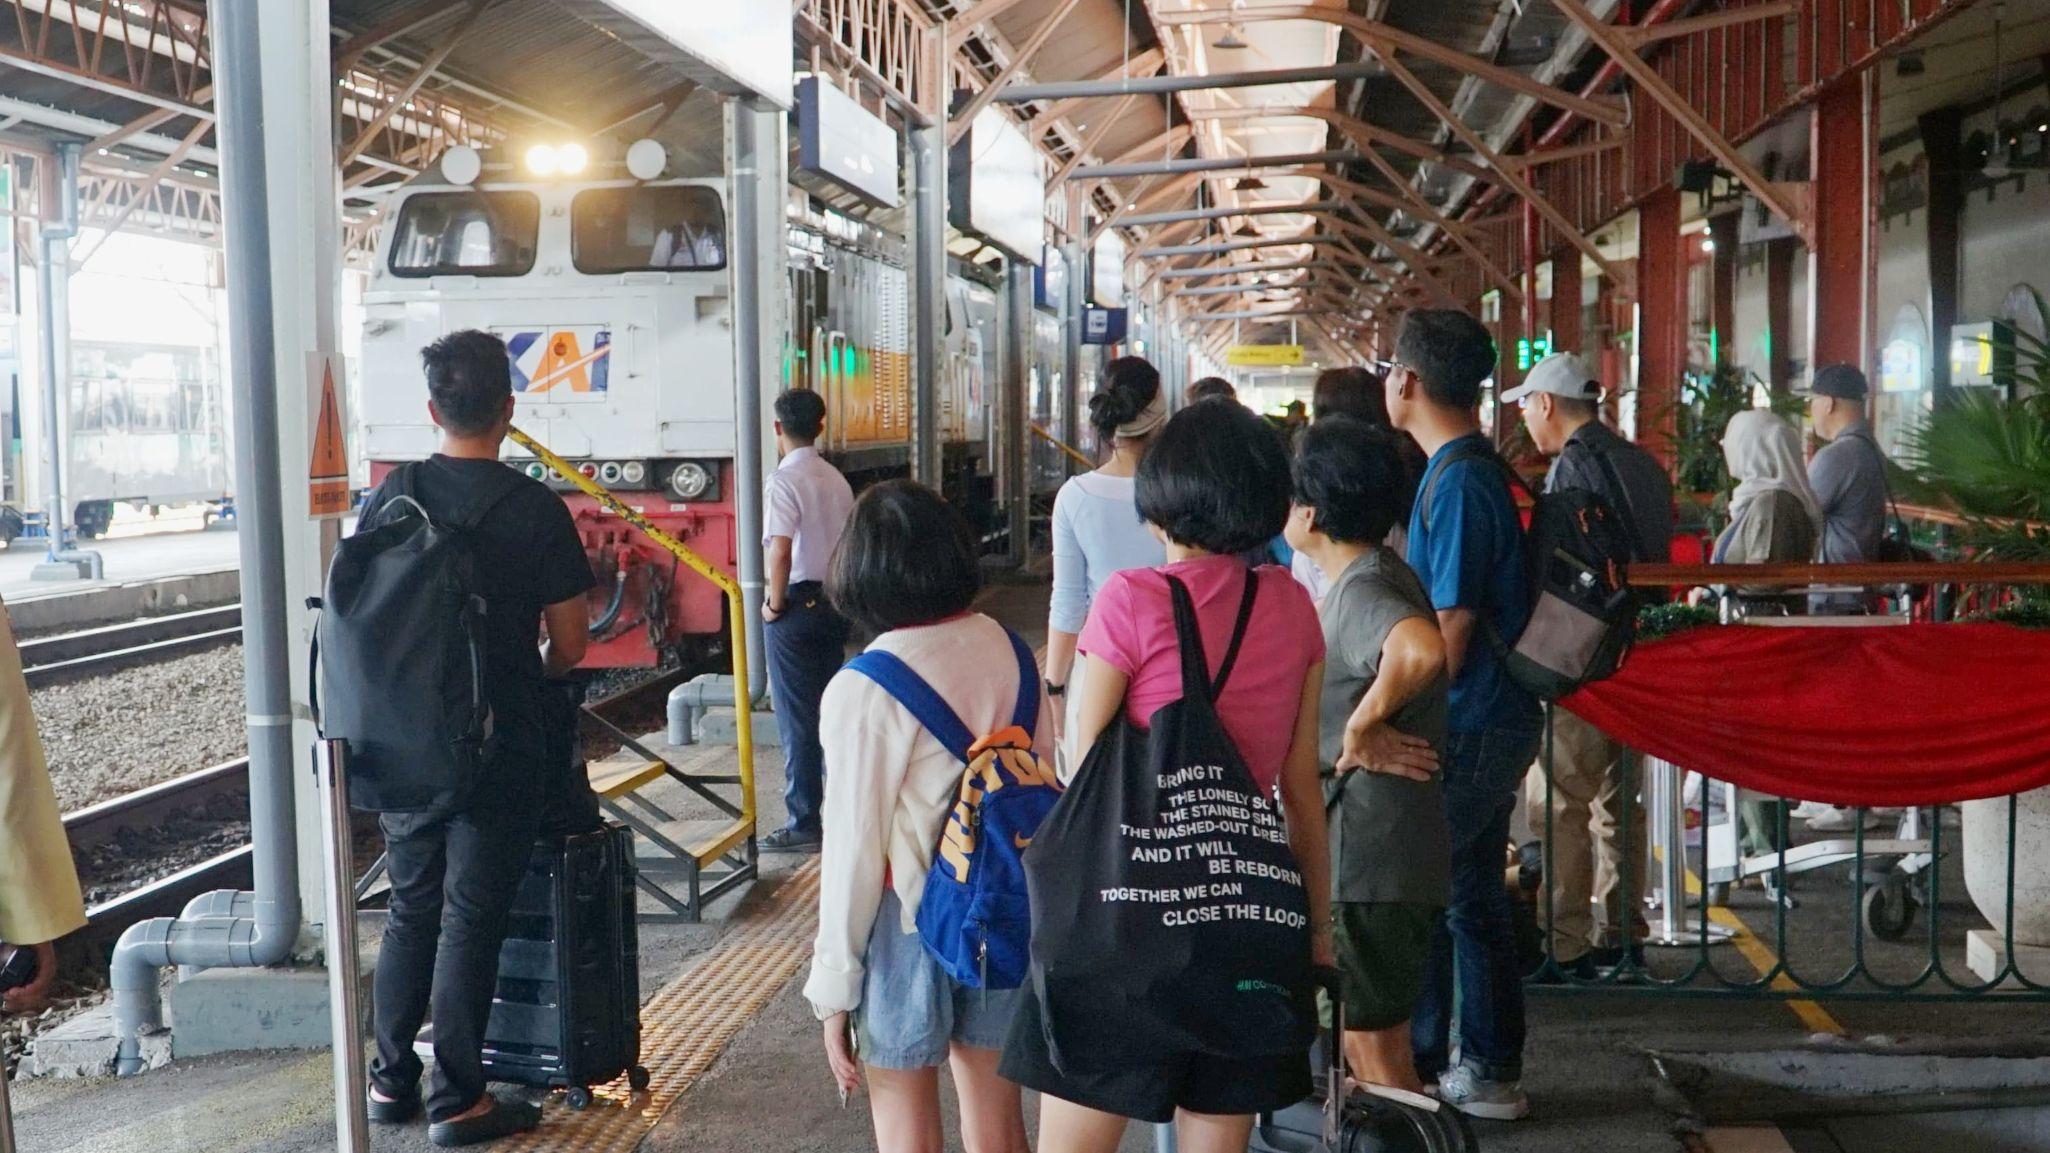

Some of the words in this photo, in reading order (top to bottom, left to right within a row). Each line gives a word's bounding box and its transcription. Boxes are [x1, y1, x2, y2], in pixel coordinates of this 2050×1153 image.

[507, 331, 611, 392] KAI
[1157, 765, 1205, 789] BRING
[1208, 765, 1224, 781] IT
[1168, 789, 1197, 808] THE
[1198, 788, 1250, 806] LONELY
[1160, 808, 1189, 824] THE
[1191, 804, 1251, 820] STAINED
[1120, 823, 1151, 840] THE
[1153, 820, 1249, 840] WASHED-OUT
[1131, 846, 1172, 863] AND
[1175, 844, 1193, 861] IT
[1195, 841, 1238, 857] WILL
[1208, 858, 1232, 875] BE
[1235, 859, 1302, 887] REBORN
[1100, 887, 1181, 903] TOGETHER
[1183, 884, 1208, 900] WE
[1210, 882, 1243, 897] CAN
[1162, 905, 1221, 927] CLOSE
[1224, 904, 1261, 920] THE
[1265, 906, 1307, 930] LOOP
